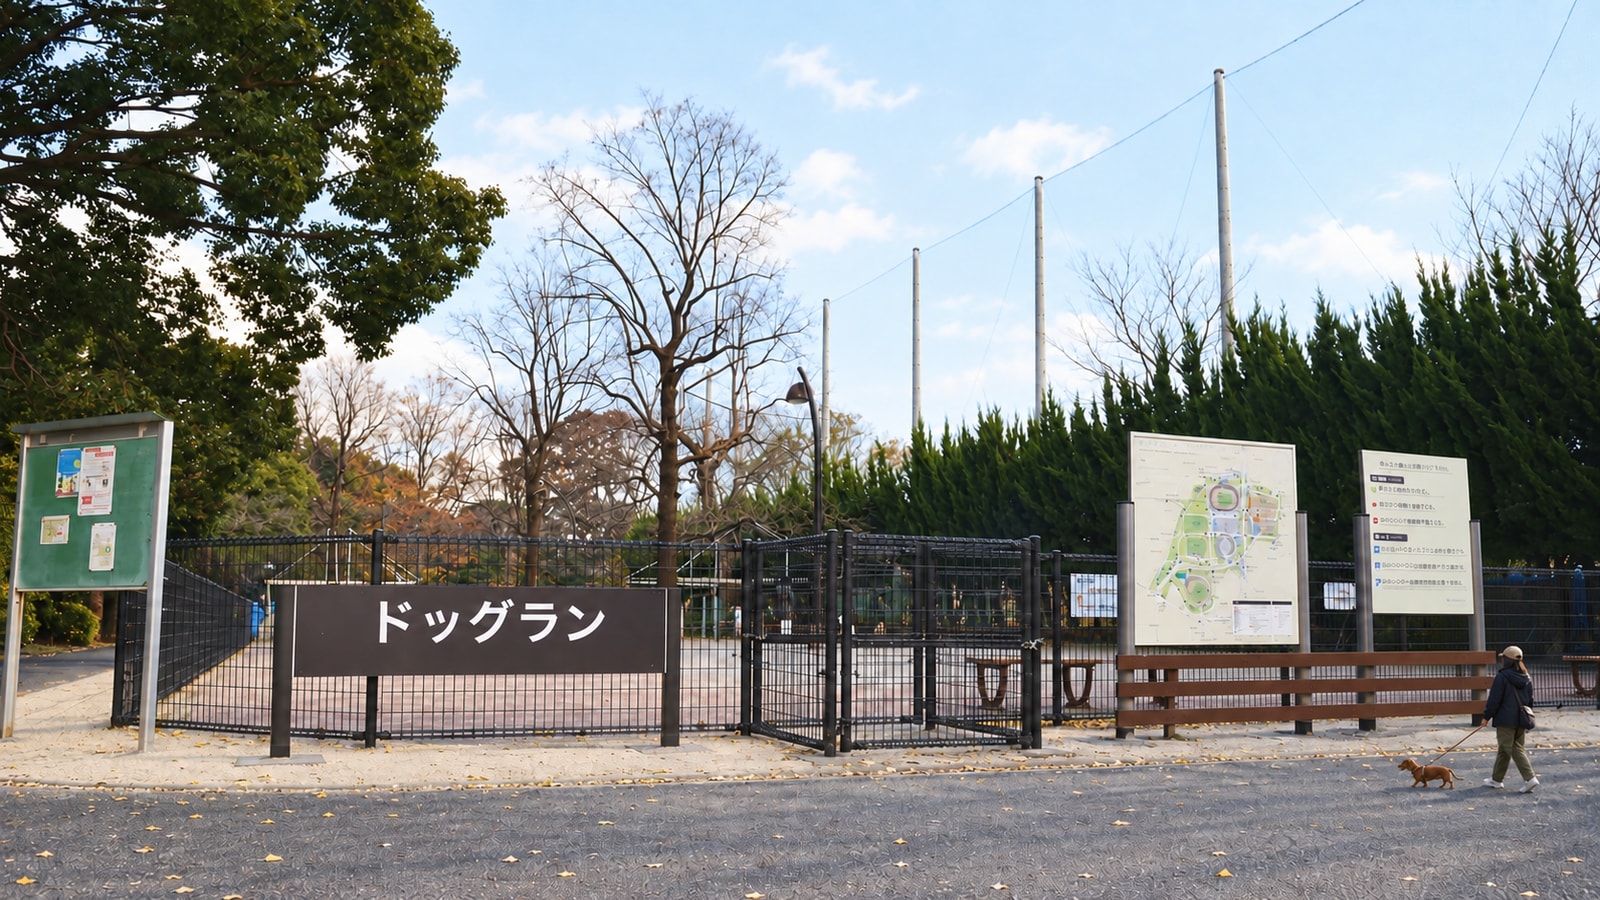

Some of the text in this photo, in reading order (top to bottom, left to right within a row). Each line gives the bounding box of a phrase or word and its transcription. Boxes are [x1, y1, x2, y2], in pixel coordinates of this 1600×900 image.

[379, 599, 605, 643] ドッグラン
